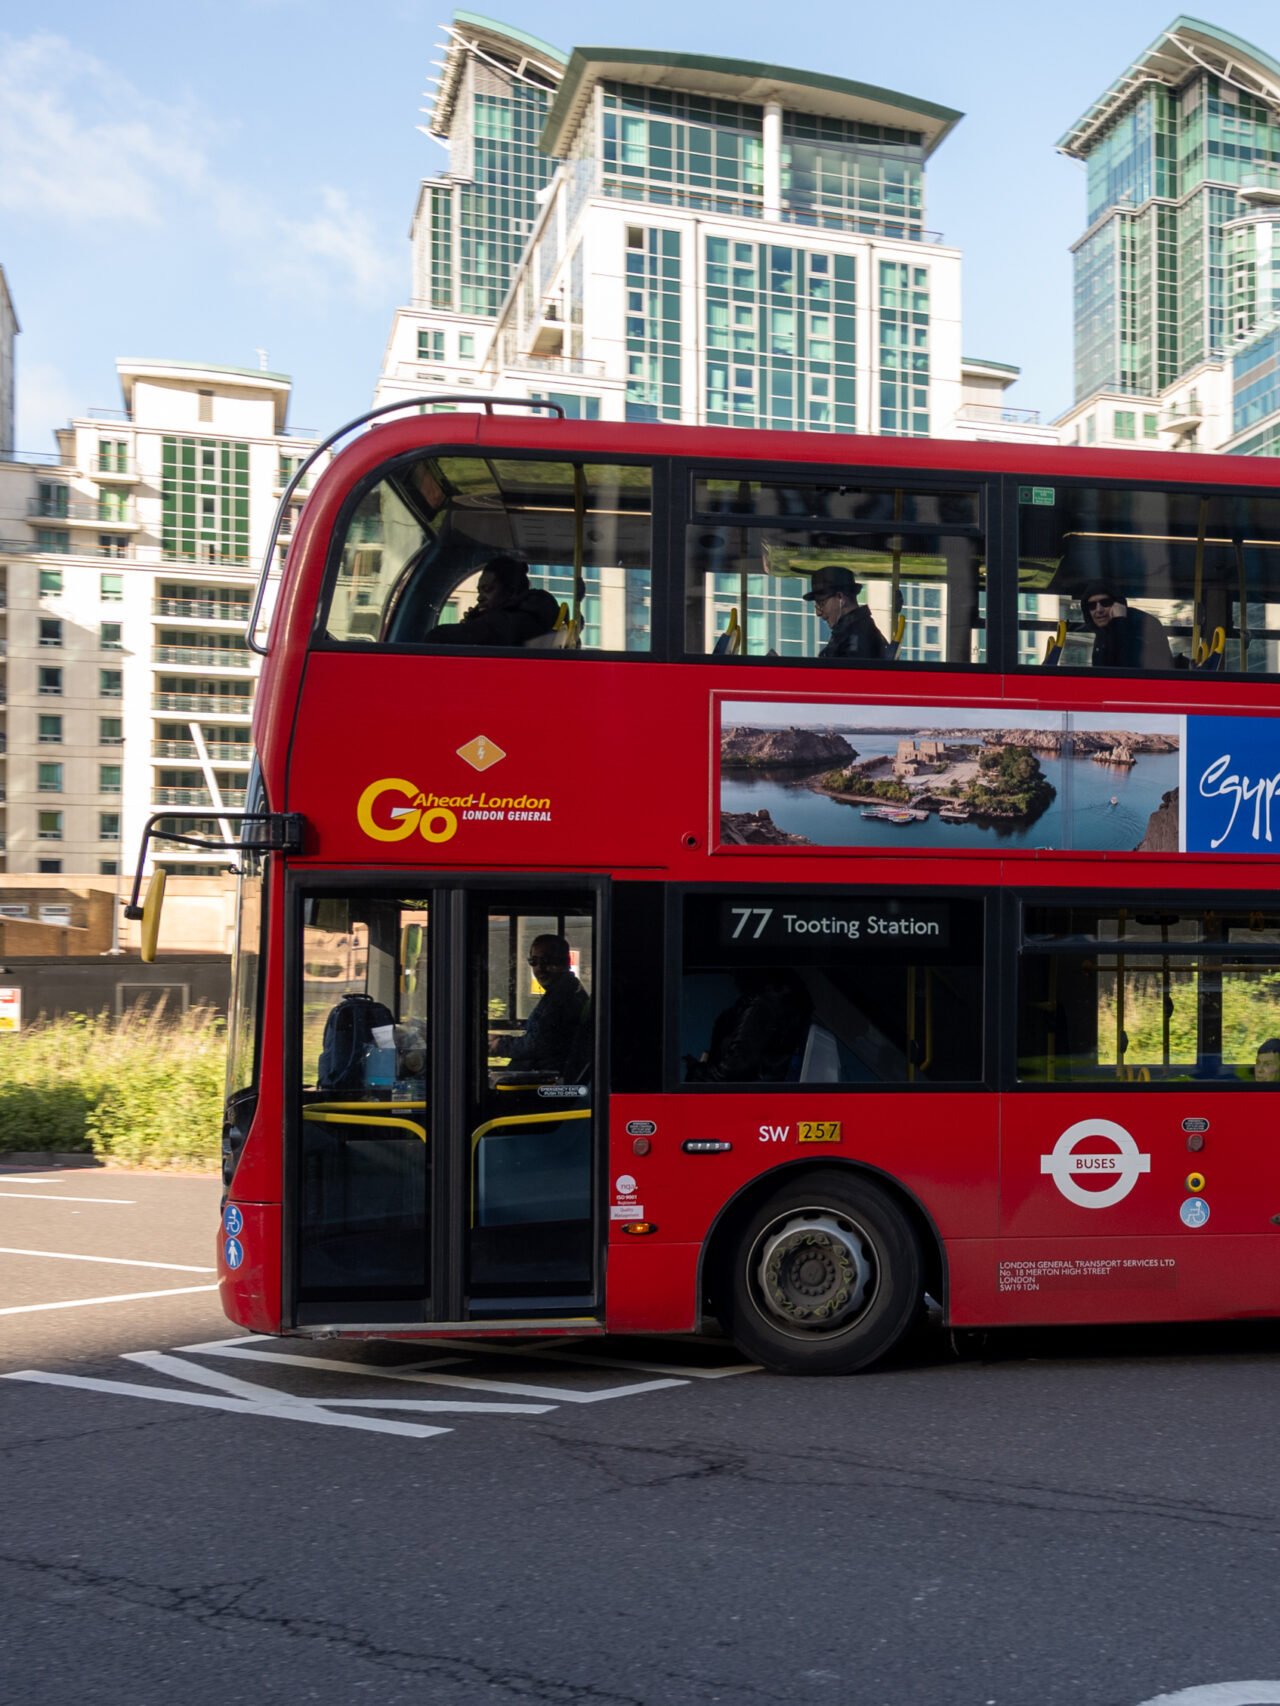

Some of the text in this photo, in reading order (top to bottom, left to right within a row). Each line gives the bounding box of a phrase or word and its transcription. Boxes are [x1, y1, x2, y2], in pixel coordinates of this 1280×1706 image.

[357, 778, 551, 843] Go Ahead-London
[462, 810, 551, 821] LONDON GENERAL
[731, 908, 939, 938] 77 Tooting Station
[758, 1125, 790, 1142] SW
[803, 1123, 838, 1139] 257
[1076, 1158, 1116, 1169] BUSES
[1000, 1261, 1036, 1269] LONDON
[1075, 1260, 1121, 1268] TRANSPORT
[1123, 1259, 1158, 1267] SERVICES
[1026, 1268, 1059, 1276] MERTON
[1083, 1267, 1111, 1275] STREET
[1000, 1276, 1036, 1284] LONDON
